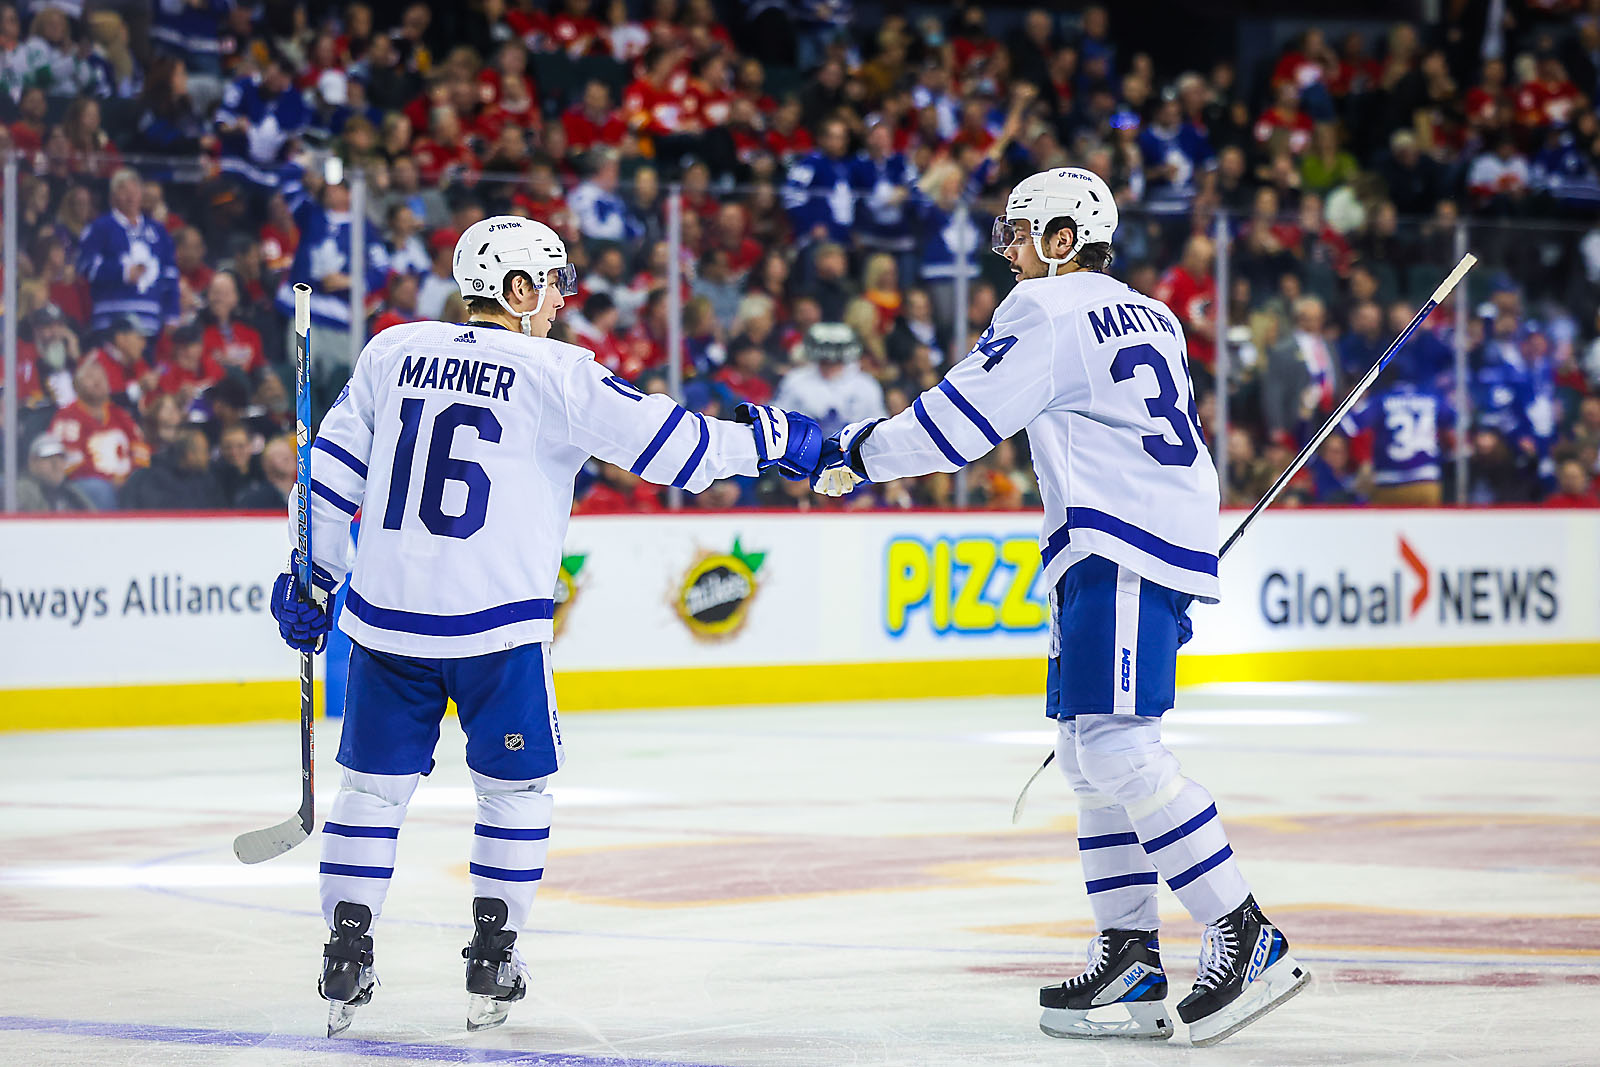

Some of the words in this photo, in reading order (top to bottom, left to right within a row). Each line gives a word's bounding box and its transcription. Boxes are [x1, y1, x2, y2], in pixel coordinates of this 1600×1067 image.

[1067, 172, 1093, 183] TikTok
[496, 222, 522, 231] TikTok
[397, 355, 516, 402] MARNER
[382, 397, 503, 541] 16
[0, 578, 110, 628] hways
[121, 574, 264, 617] Alliance
[884, 534, 1048, 637] PIZZ
[1259, 571, 1403, 627] Global
[1437, 570, 1560, 625] NEWS
[1120, 647, 1131, 693] CCM
[1122, 965, 1145, 988] AM34
[1247, 927, 1270, 984] CCM
